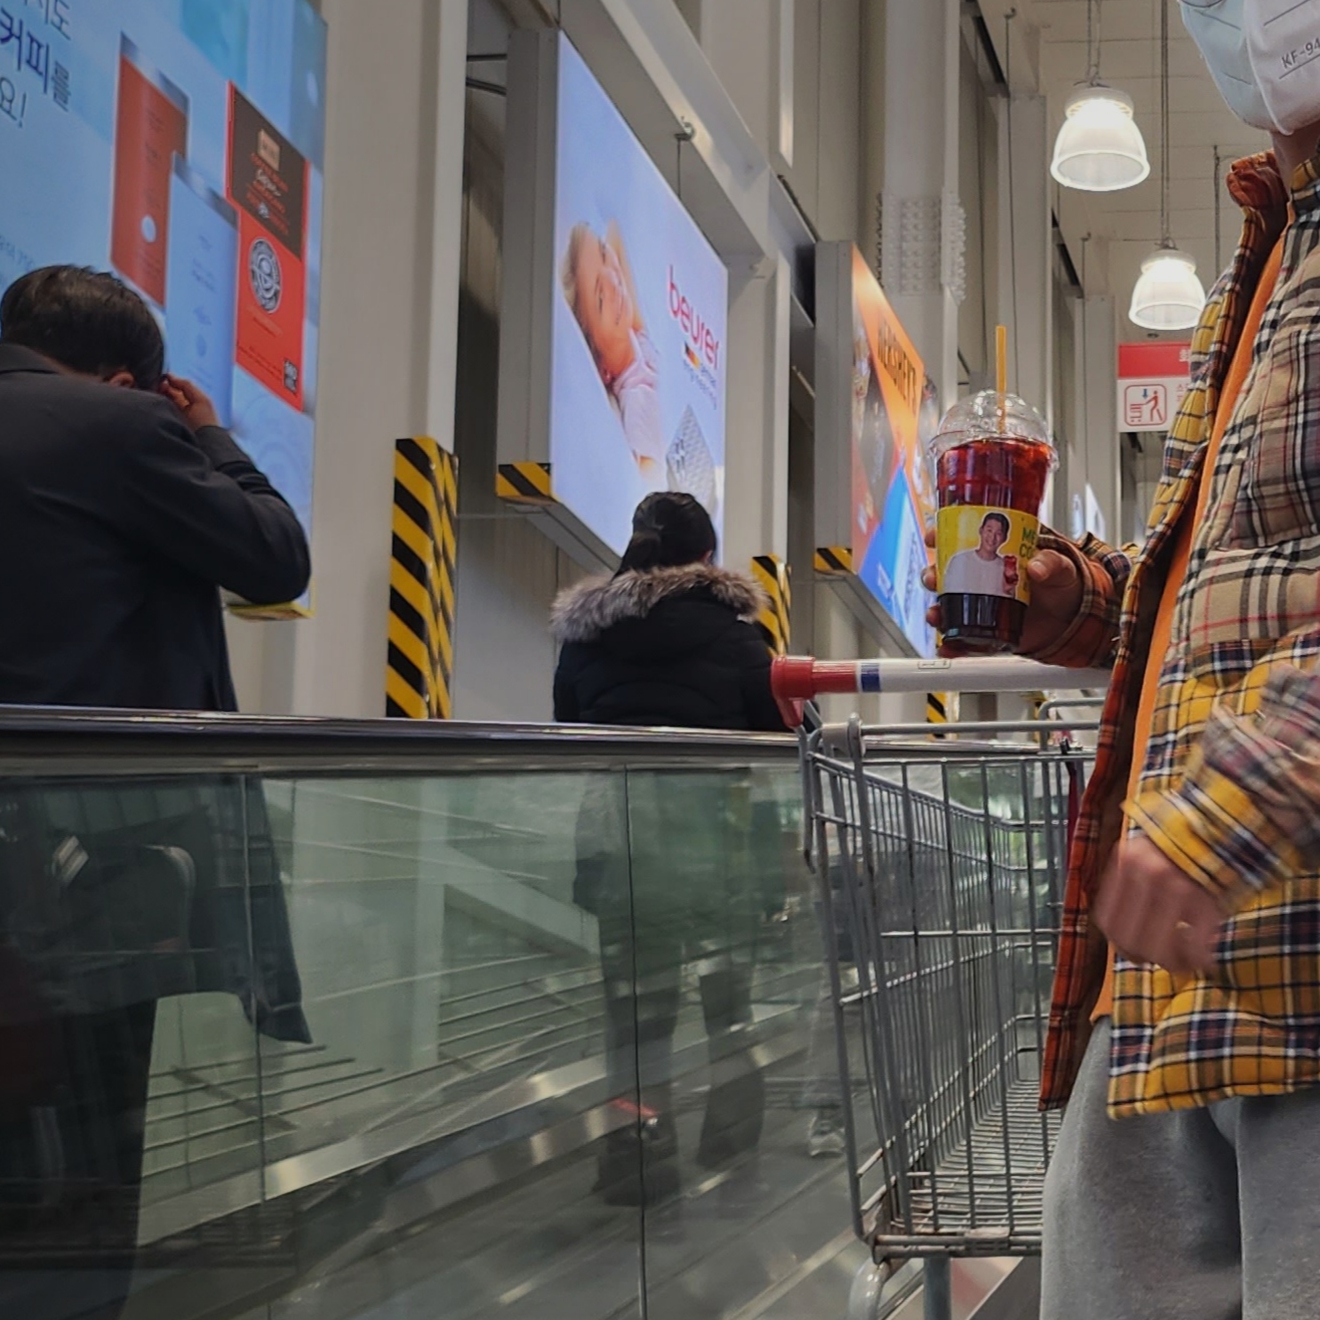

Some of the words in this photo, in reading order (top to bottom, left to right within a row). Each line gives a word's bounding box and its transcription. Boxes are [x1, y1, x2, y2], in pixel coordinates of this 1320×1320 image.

[0, 6, 71, 112] 커피를
[24, 0, 71, 41] 도
[669, 264, 720, 370] beurer
